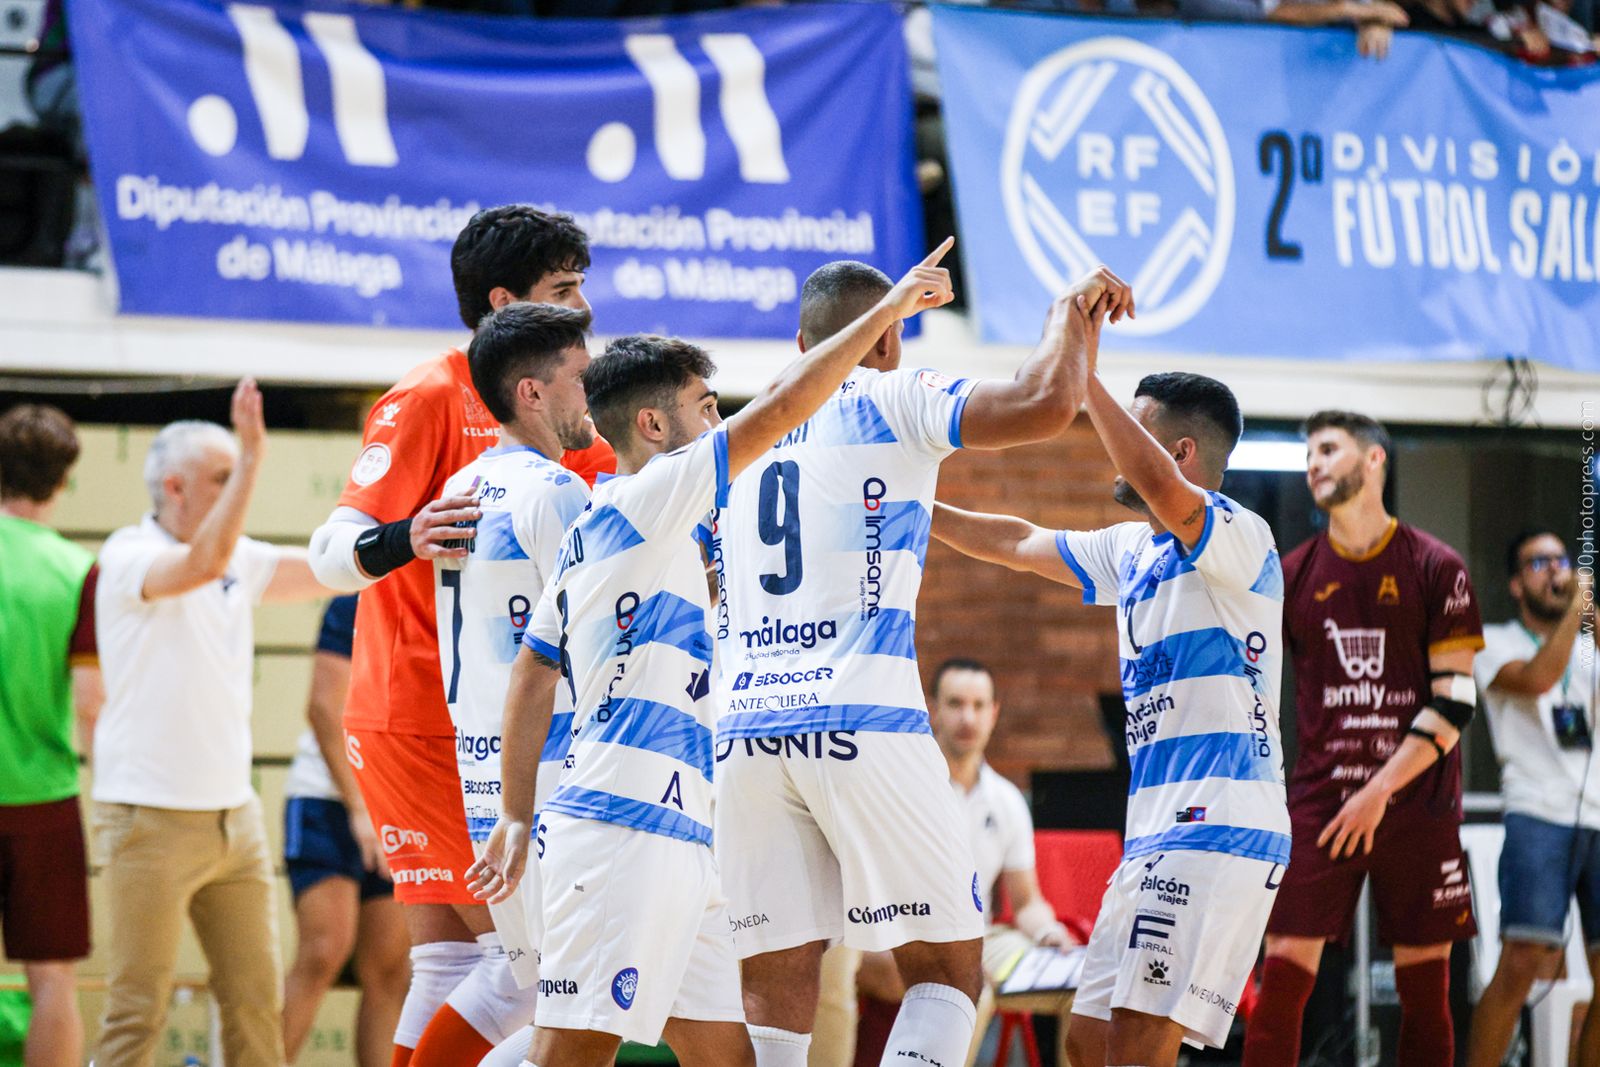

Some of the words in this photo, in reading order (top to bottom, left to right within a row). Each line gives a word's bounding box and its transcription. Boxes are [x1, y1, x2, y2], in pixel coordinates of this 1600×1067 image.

[705, 207, 875, 254] Provincial
[1332, 165, 1501, 274] FÚTBOL
[216, 235, 271, 281] de
[272, 237, 402, 299] Málaga
[612, 257, 664, 301] de
[665, 258, 798, 312] Málaga
[758, 459, 803, 596] 9
[441, 569, 463, 704] 7
[848, 902, 931, 925] Cómpeta
[1157, 892, 1188, 906] viajes
